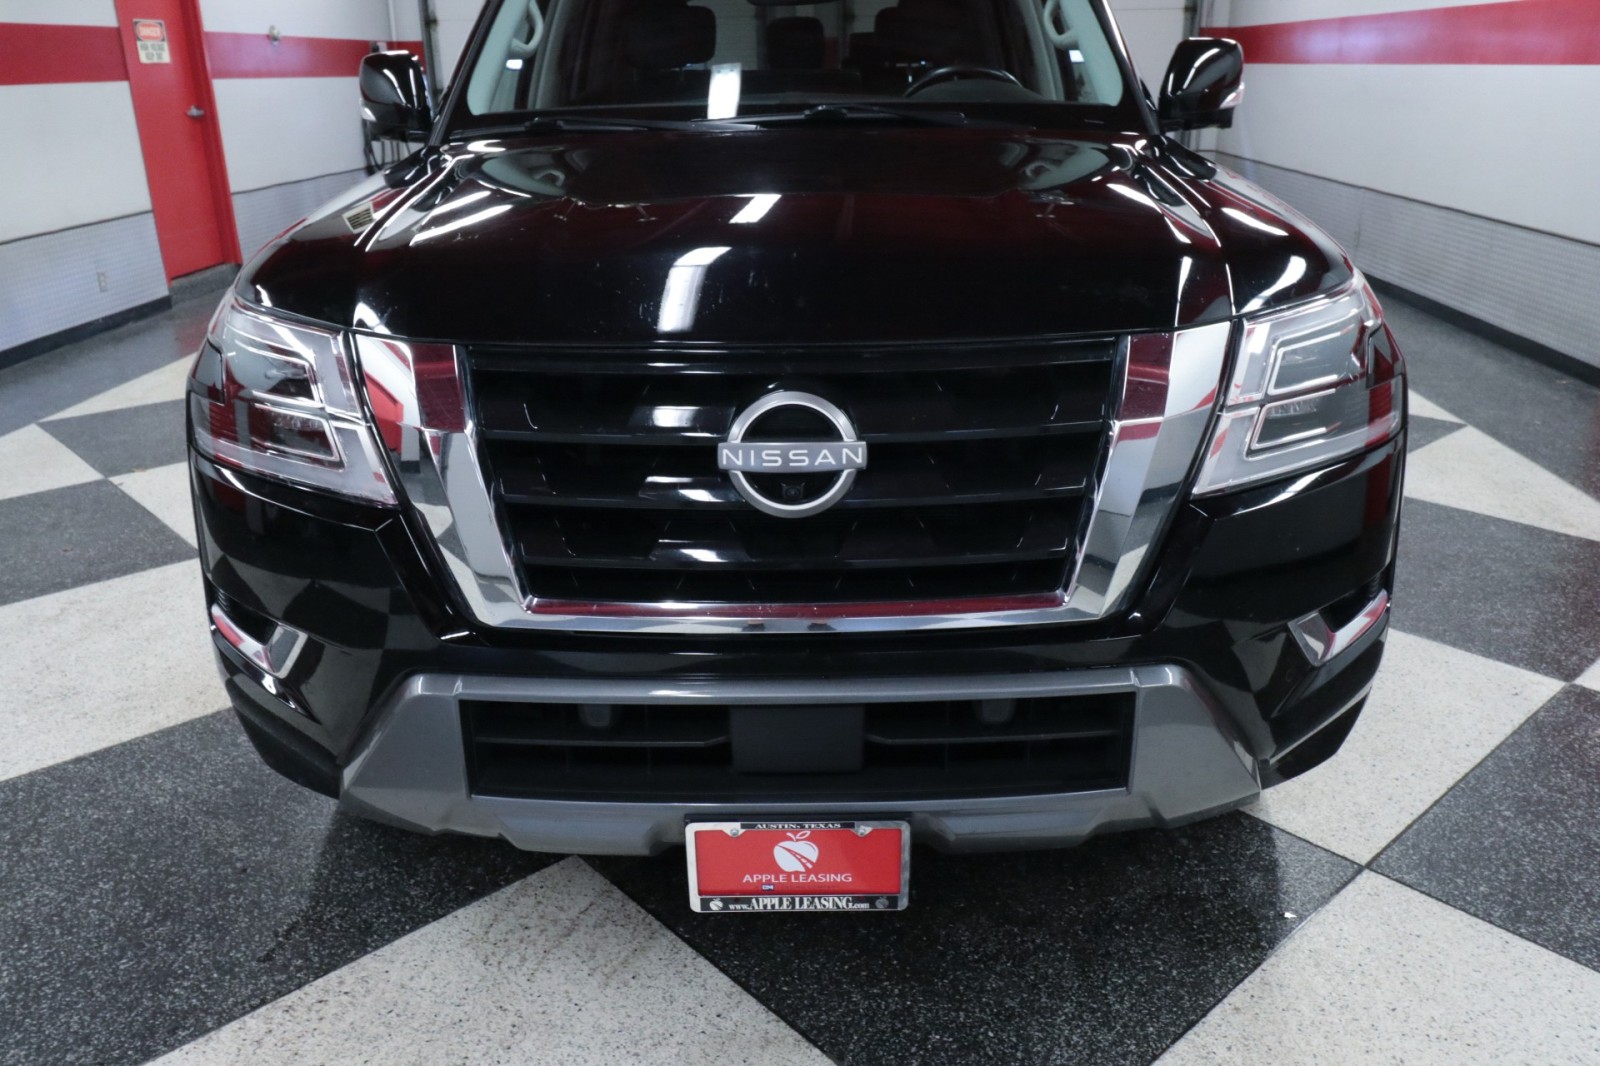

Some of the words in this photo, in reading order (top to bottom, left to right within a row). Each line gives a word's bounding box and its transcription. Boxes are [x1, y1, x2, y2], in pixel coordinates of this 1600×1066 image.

[722, 448, 863, 466] NISSAN
[742, 873, 788, 883] APPLE
[791, 873, 853, 883] LEASING
